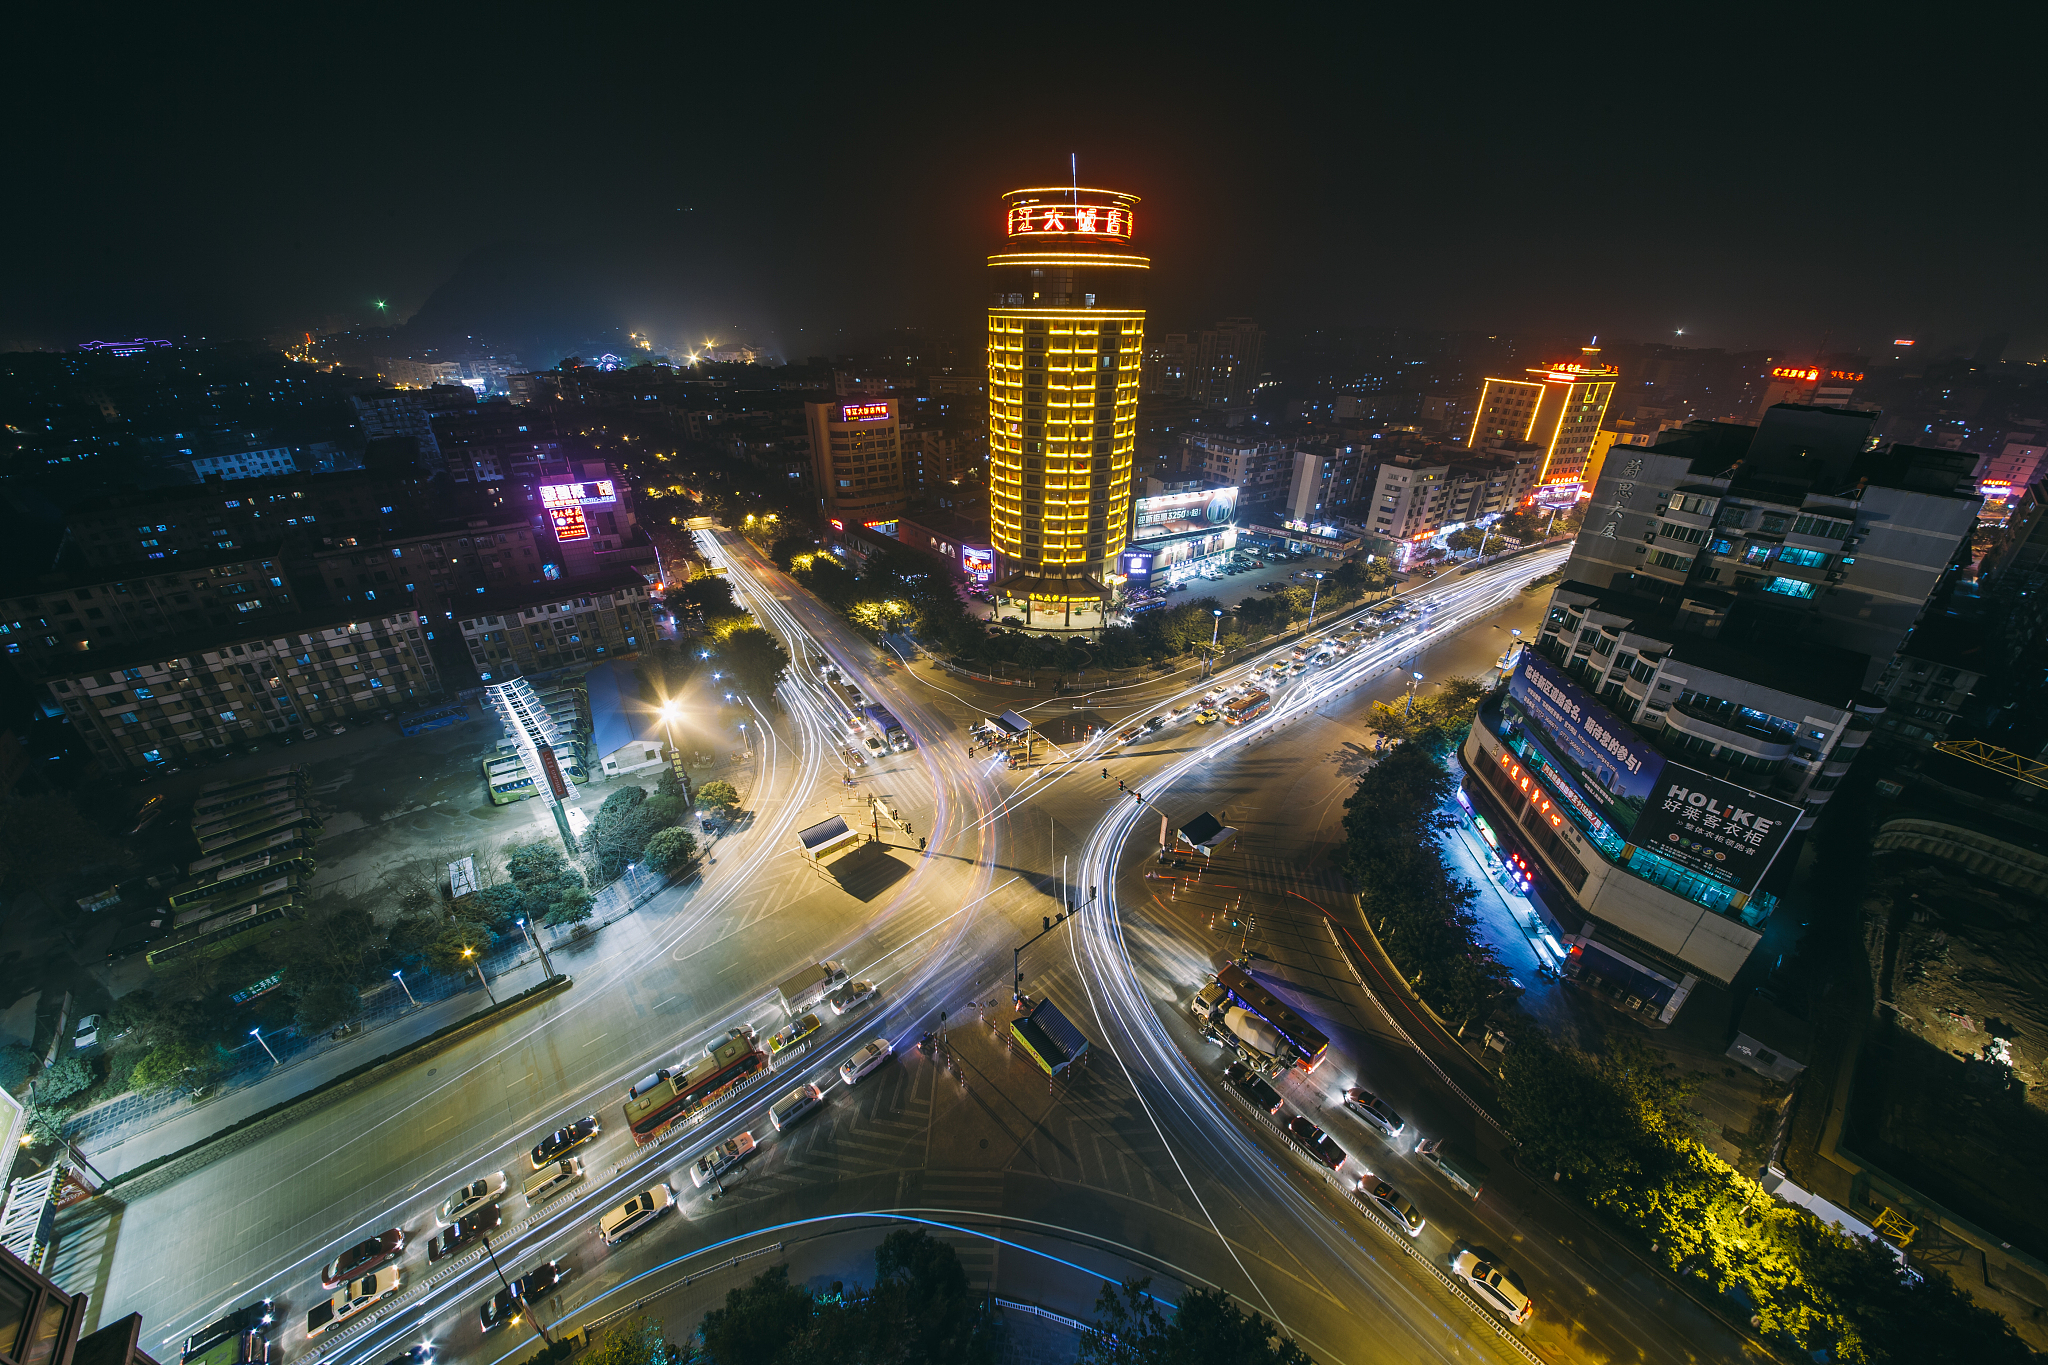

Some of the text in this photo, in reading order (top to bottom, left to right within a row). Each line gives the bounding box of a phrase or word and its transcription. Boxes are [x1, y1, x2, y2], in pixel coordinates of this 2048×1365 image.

[1661, 798, 1765, 847] 好莱客衣柜
